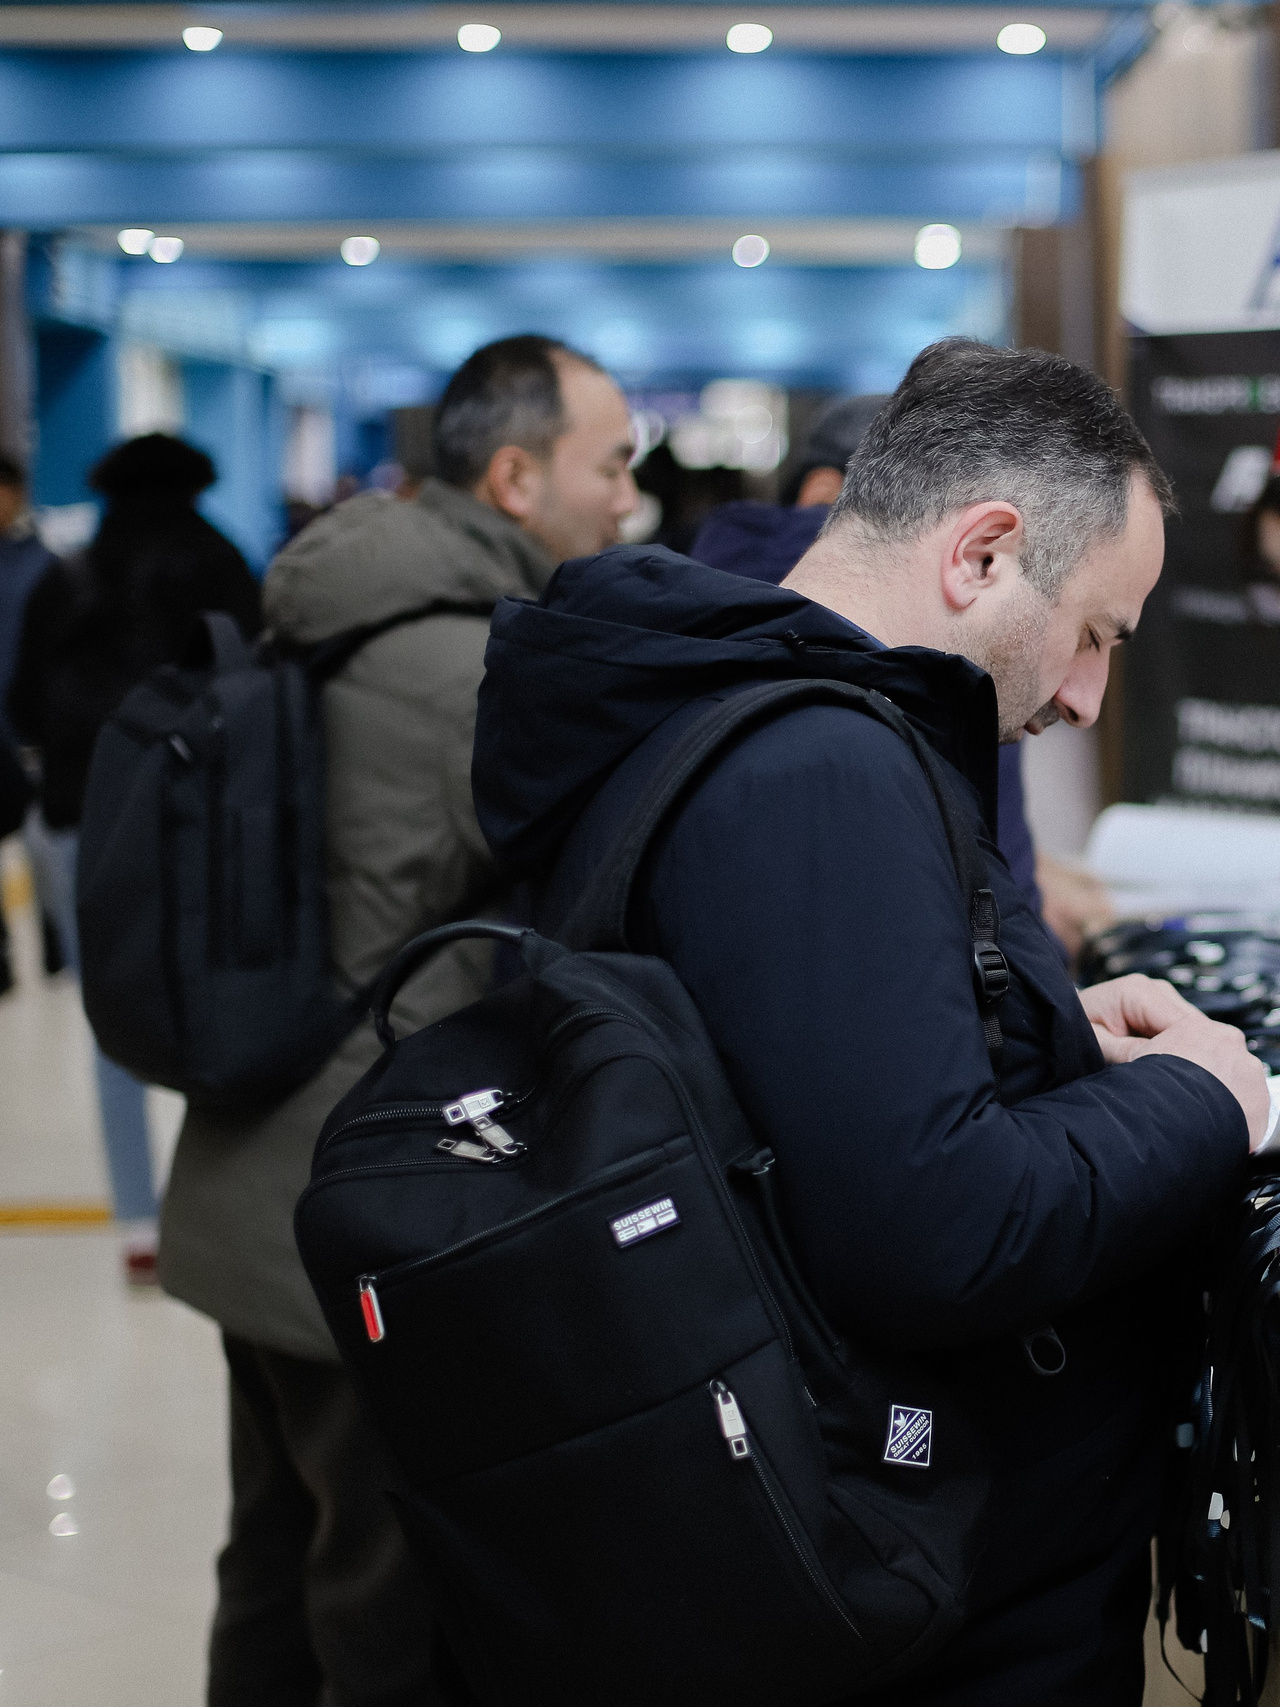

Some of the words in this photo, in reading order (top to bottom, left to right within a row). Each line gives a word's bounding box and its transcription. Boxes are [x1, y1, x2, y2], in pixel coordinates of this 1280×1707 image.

[613, 1198, 673, 1231] SUISSEWIN
[890, 1413, 928, 1454] SUISSEWIN
[909, 1419, 930, 1443] OUTDOOR
